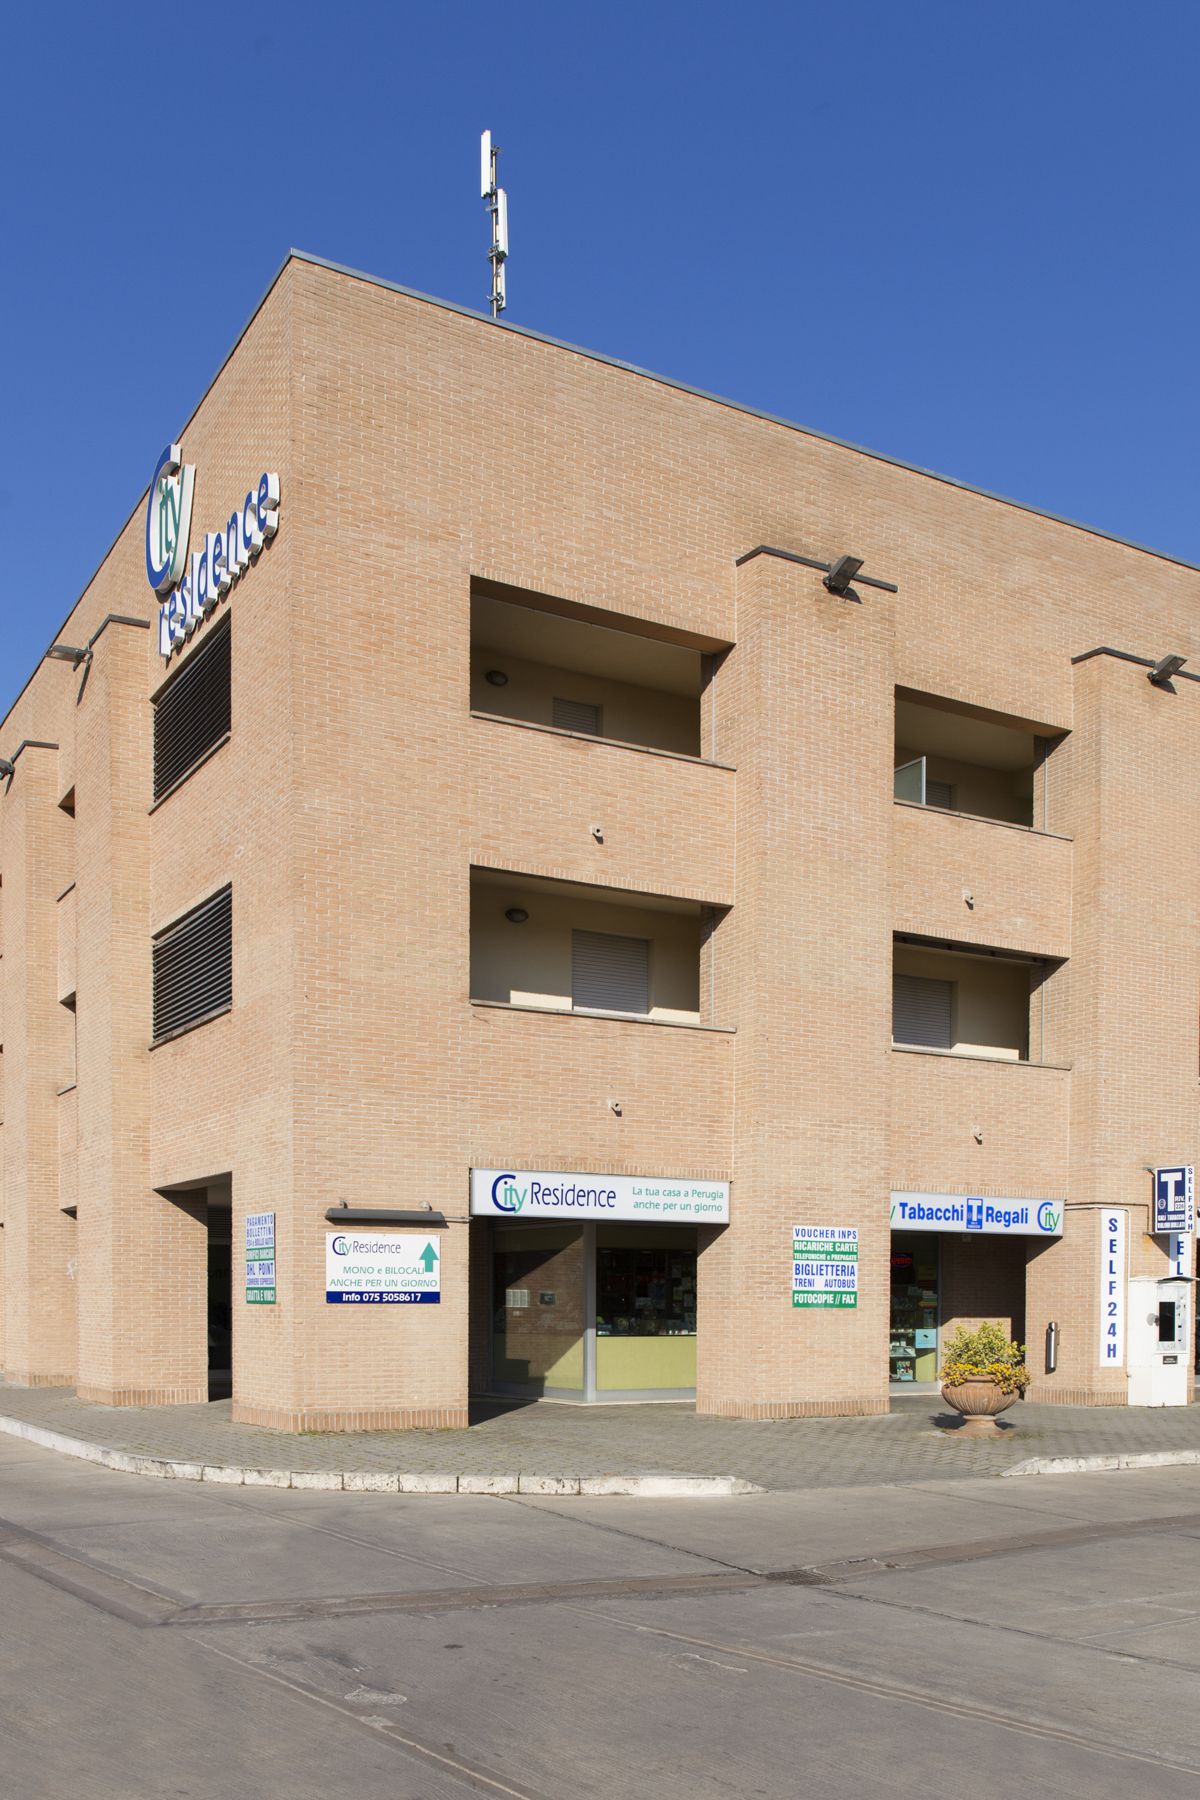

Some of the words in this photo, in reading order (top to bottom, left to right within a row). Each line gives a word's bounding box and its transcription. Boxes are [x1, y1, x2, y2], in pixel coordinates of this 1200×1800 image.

[146, 444, 196, 590] City
[158, 473, 280, 658] residence
[491, 1174, 527, 1214] City
[530, 1182, 616, 1208] Residence
[632, 1187, 642, 1195] La
[645, 1188, 660, 1196] tua
[662, 1189, 681, 1197] casa
[691, 1189, 724, 1201] Perugia
[633, 1200, 660, 1209] anche
[663, 1202, 677, 1211] per
[694, 1203, 722, 1213] giorno
[247, 1215, 273, 1226] PAGAMENTO
[899, 1202, 964, 1221] Tabacchi
[986, 1206, 1028, 1227] Regali
[1037, 1202, 1060, 1232] City
[246, 1226, 273, 1238] BOLLETTINI
[795, 1228, 836, 1238] VOUCHER
[838, 1230, 857, 1239] INPS
[332, 1236, 352, 1256] City
[352, 1240, 401, 1254] Residence
[794, 1241, 834, 1251] RICARICHE
[835, 1243, 857, 1252] CARTE
[258, 1262, 273, 1275] POINT
[343, 1266, 374, 1274] MONO
[795, 1263, 855, 1276] BIGLIETTERIA
[330, 1279, 362, 1287] ANCHE
[366, 1279, 382, 1287] PER
[401, 1279, 437, 1287] GIORNO
[794, 1278, 815, 1287] TRENI
[824, 1279, 855, 1288] AUTOBUS
[342, 1293, 360, 1301] Info
[363, 1293, 380, 1301] 075
[383, 1293, 421, 1302] 5058617
[794, 1294, 834, 1303] FOTOCOPIE
[842, 1294, 855, 1304] FAX
